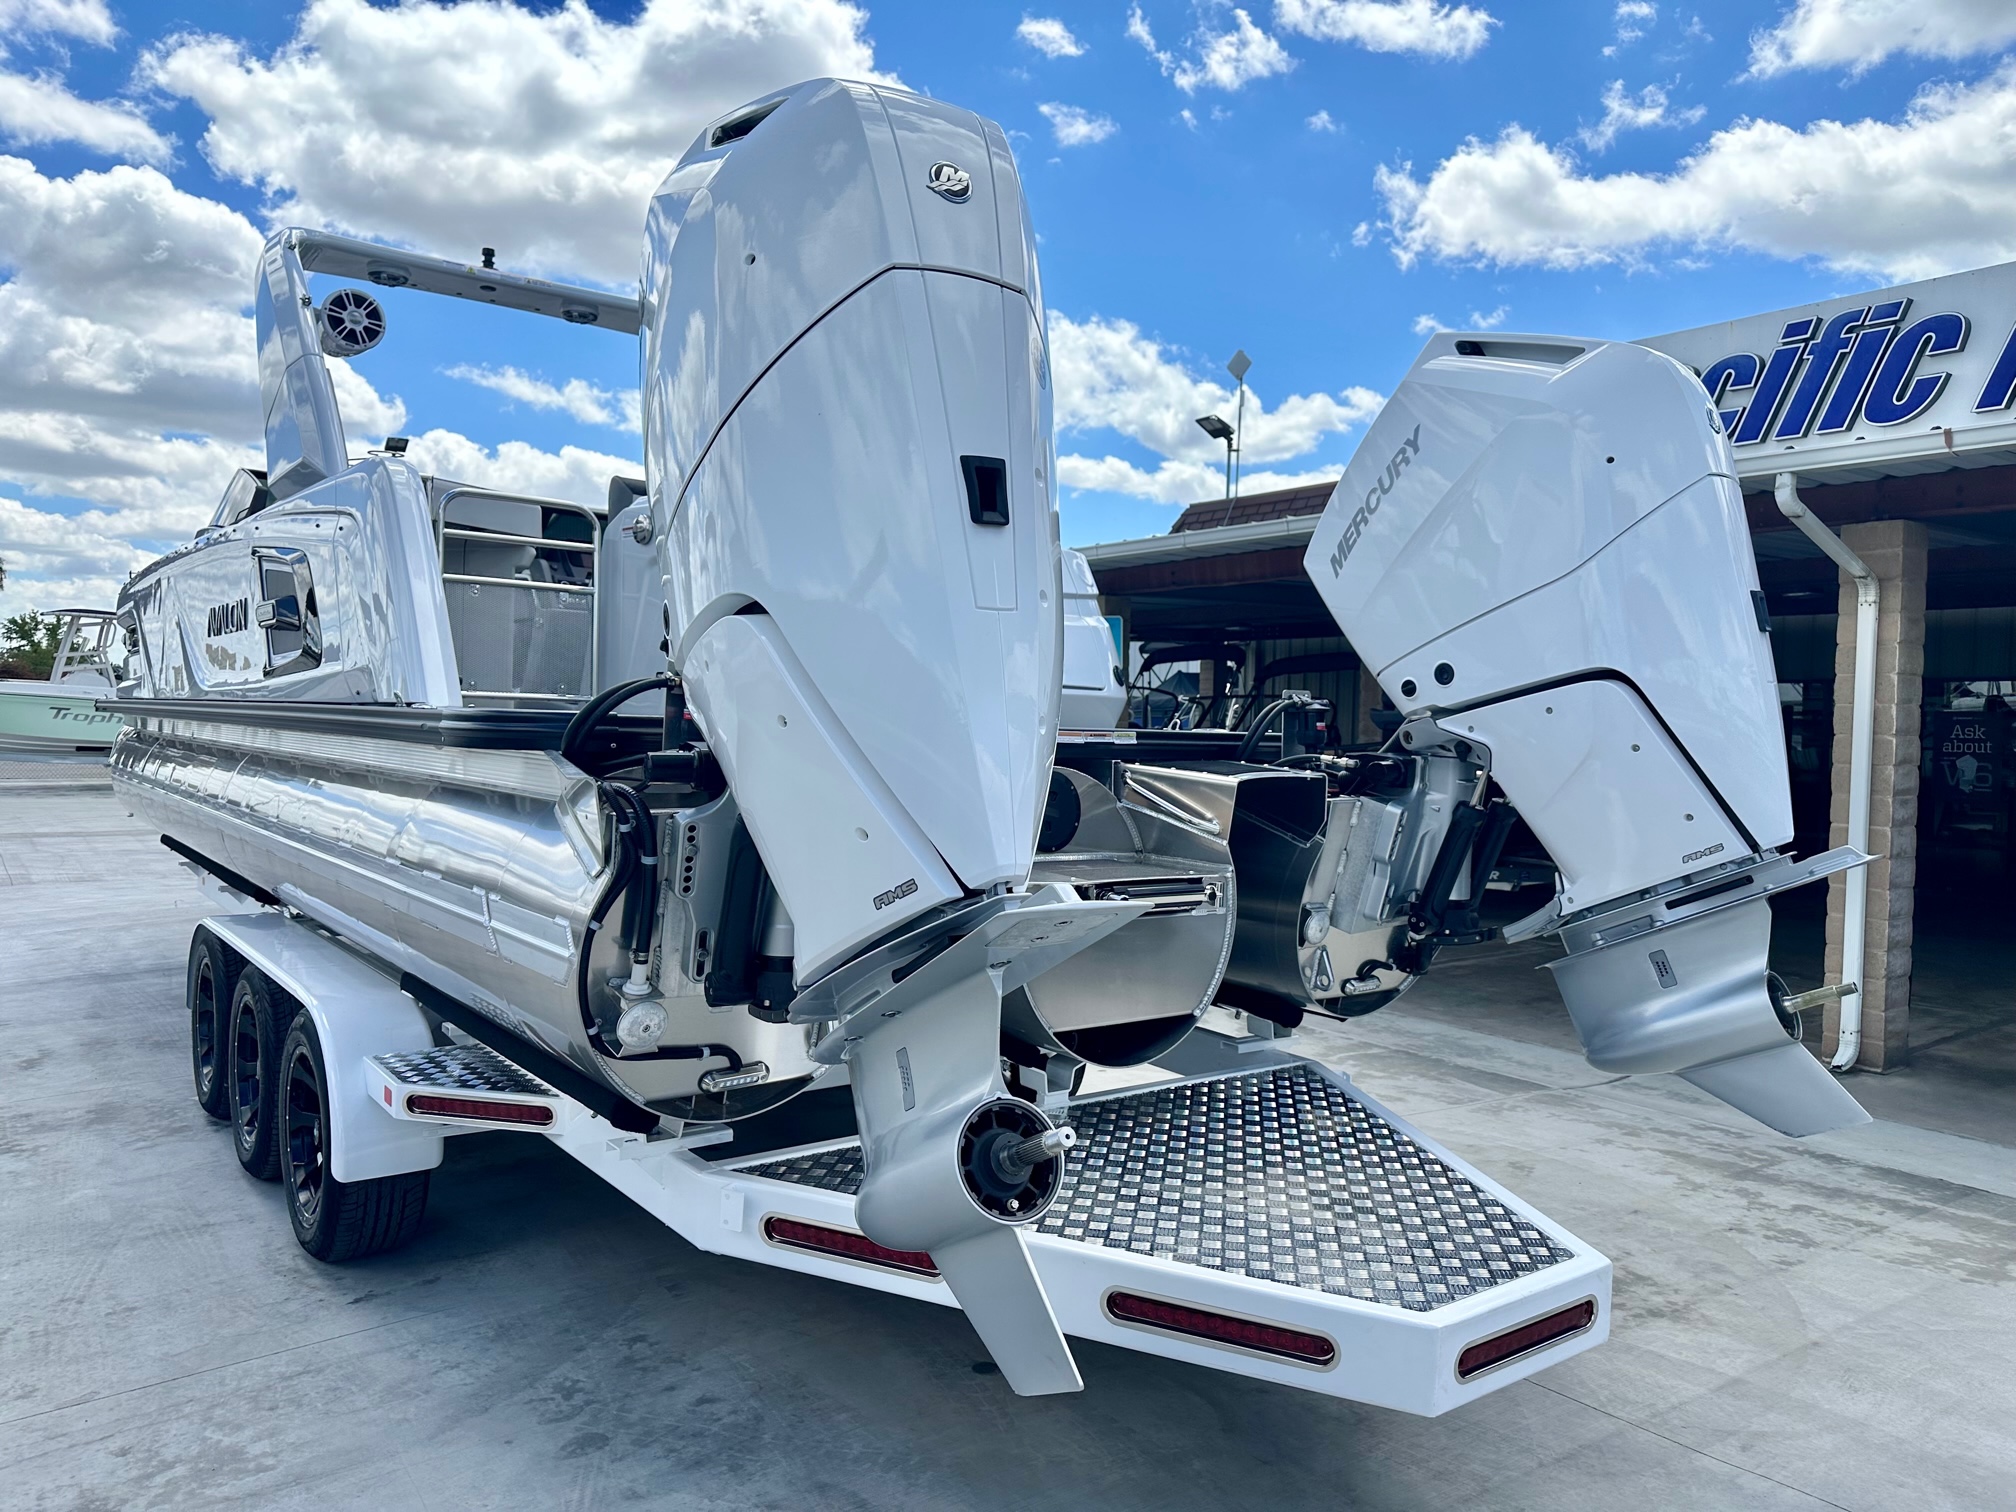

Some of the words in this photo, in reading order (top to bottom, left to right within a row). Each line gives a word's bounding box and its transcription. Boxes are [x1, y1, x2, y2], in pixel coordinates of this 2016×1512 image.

[1697, 297, 1971, 447] cific
[1329, 423, 1421, 580] MERCURY
[207, 597, 249, 638] AVALON
[48, 706, 125, 726] Troph
[1950, 724, 1987, 739] Ask
[1942, 740, 1993, 753] about
[1682, 842, 1725, 864] AMS
[872, 877, 919, 911] AMS
